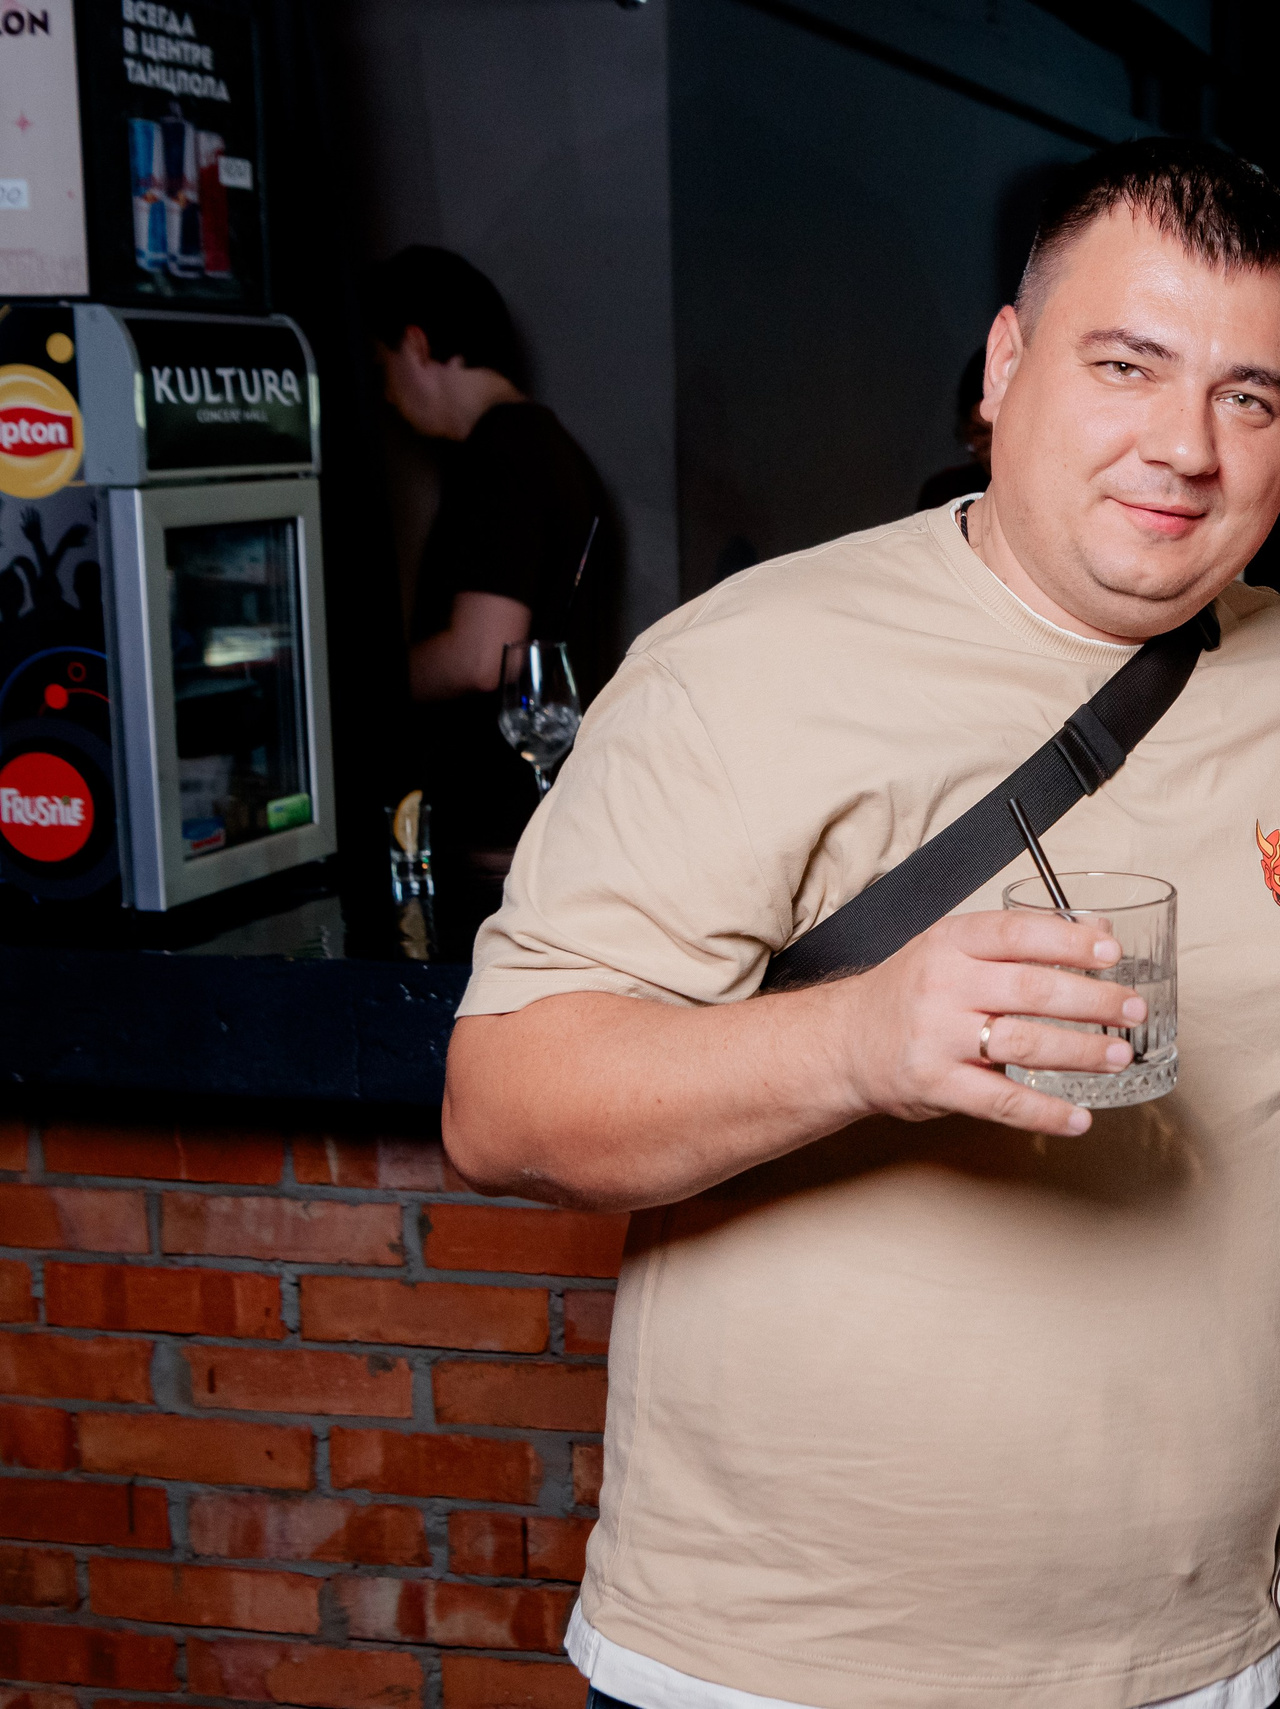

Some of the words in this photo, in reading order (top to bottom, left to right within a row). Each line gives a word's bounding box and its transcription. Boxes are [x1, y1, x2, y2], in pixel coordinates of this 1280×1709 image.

[0, 10, 50, 36] ON
[122, 0, 196, 38] ВСЕГДА
[123, 26, 138, 54] В
[141, 30, 213, 71] ЦЕНТРЕ
[123, 57, 231, 103] ТАНЦПОЛА
[151, 366, 301, 406] KULTURA
[0, 418, 68, 449] pton
